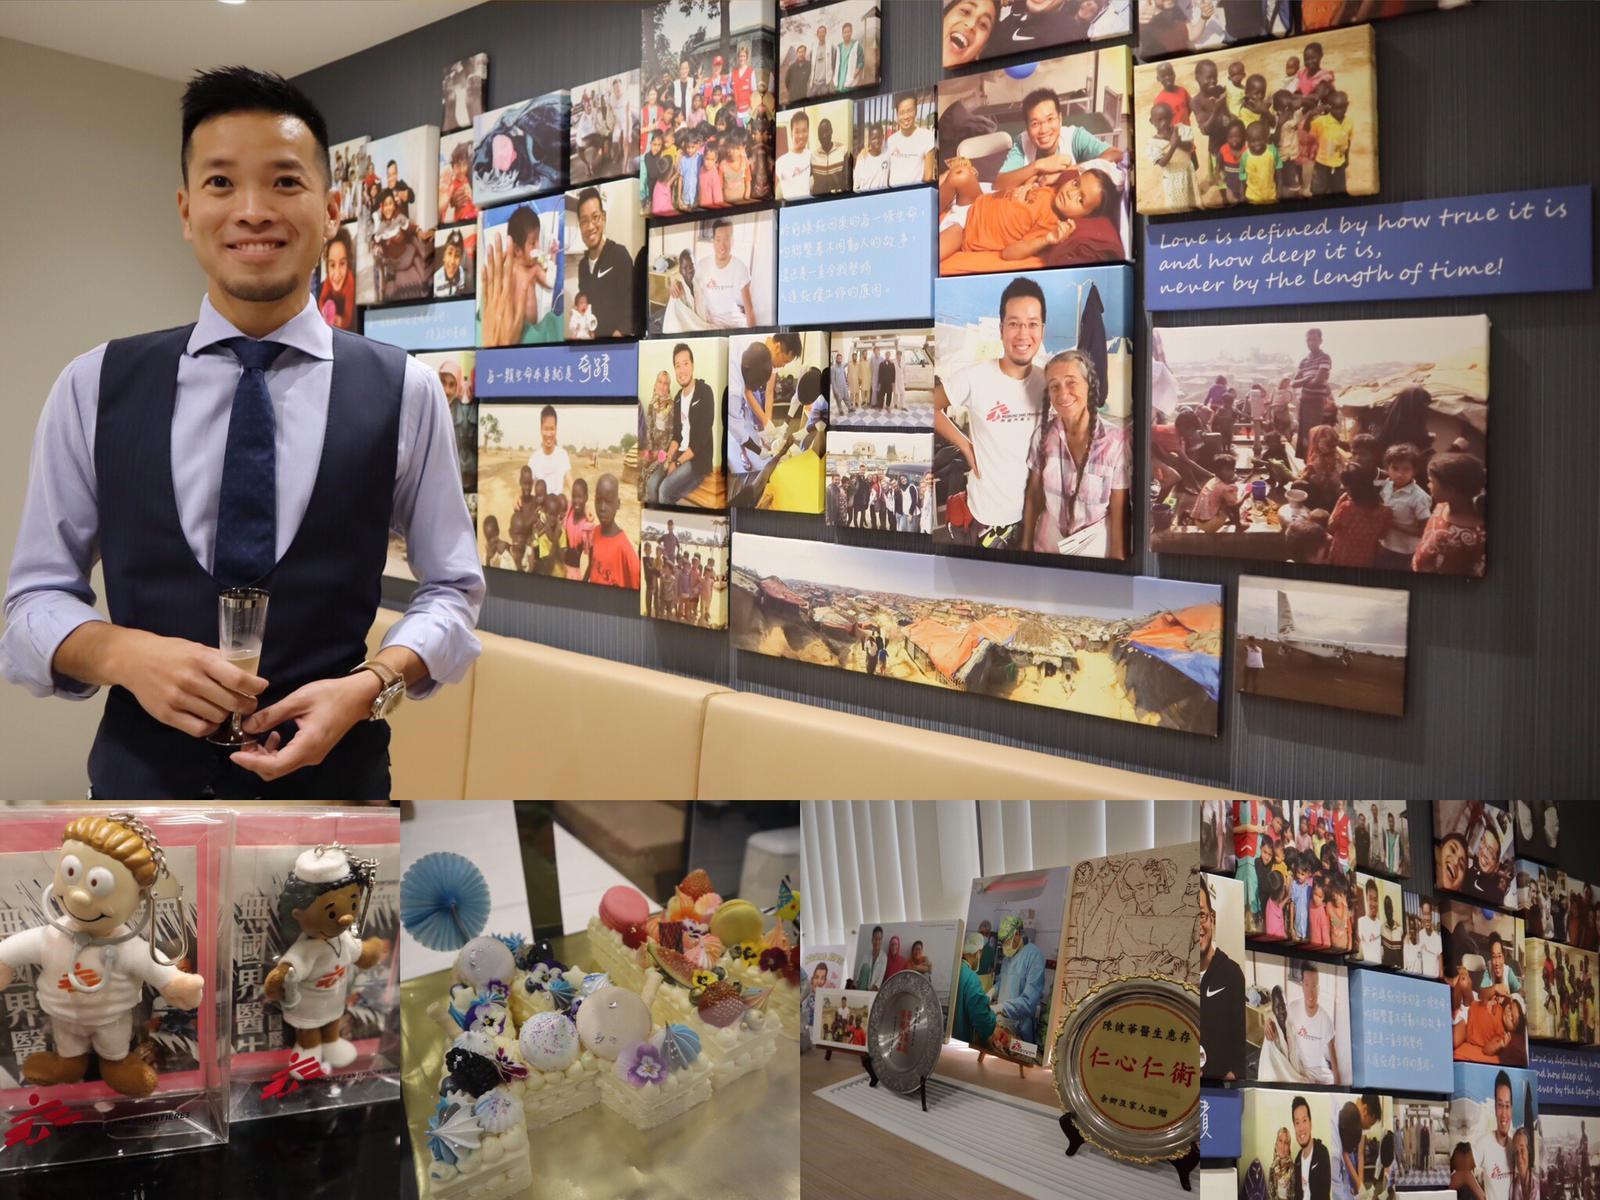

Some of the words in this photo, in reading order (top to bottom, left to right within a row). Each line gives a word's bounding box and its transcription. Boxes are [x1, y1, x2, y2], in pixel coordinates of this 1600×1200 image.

[1159, 231, 1208, 250] Love
[1215, 229, 1233, 244] is
[1239, 215, 1332, 245] defined
[1338, 215, 1368, 239] by
[1376, 212, 1431, 231] how
[1439, 203, 1499, 225] true
[1508, 200, 1535, 221] it
[1544, 197, 1568, 219] is
[1159, 251, 1202, 272] and
[1208, 246, 1254, 268] how
[1261, 241, 1317, 268] deep
[1324, 240, 1347, 260] it
[1355, 239, 1383, 260] is,
[1159, 276, 1224, 296] never
[1232, 272, 1260, 295] by
[1266, 270, 1306, 289] the
[1313, 263, 1394, 289] length
[1399, 264, 1423, 286] of
[1429, 258, 1503, 281] time!
[1089, 1045, 1197, 1089] 仁心仁術
